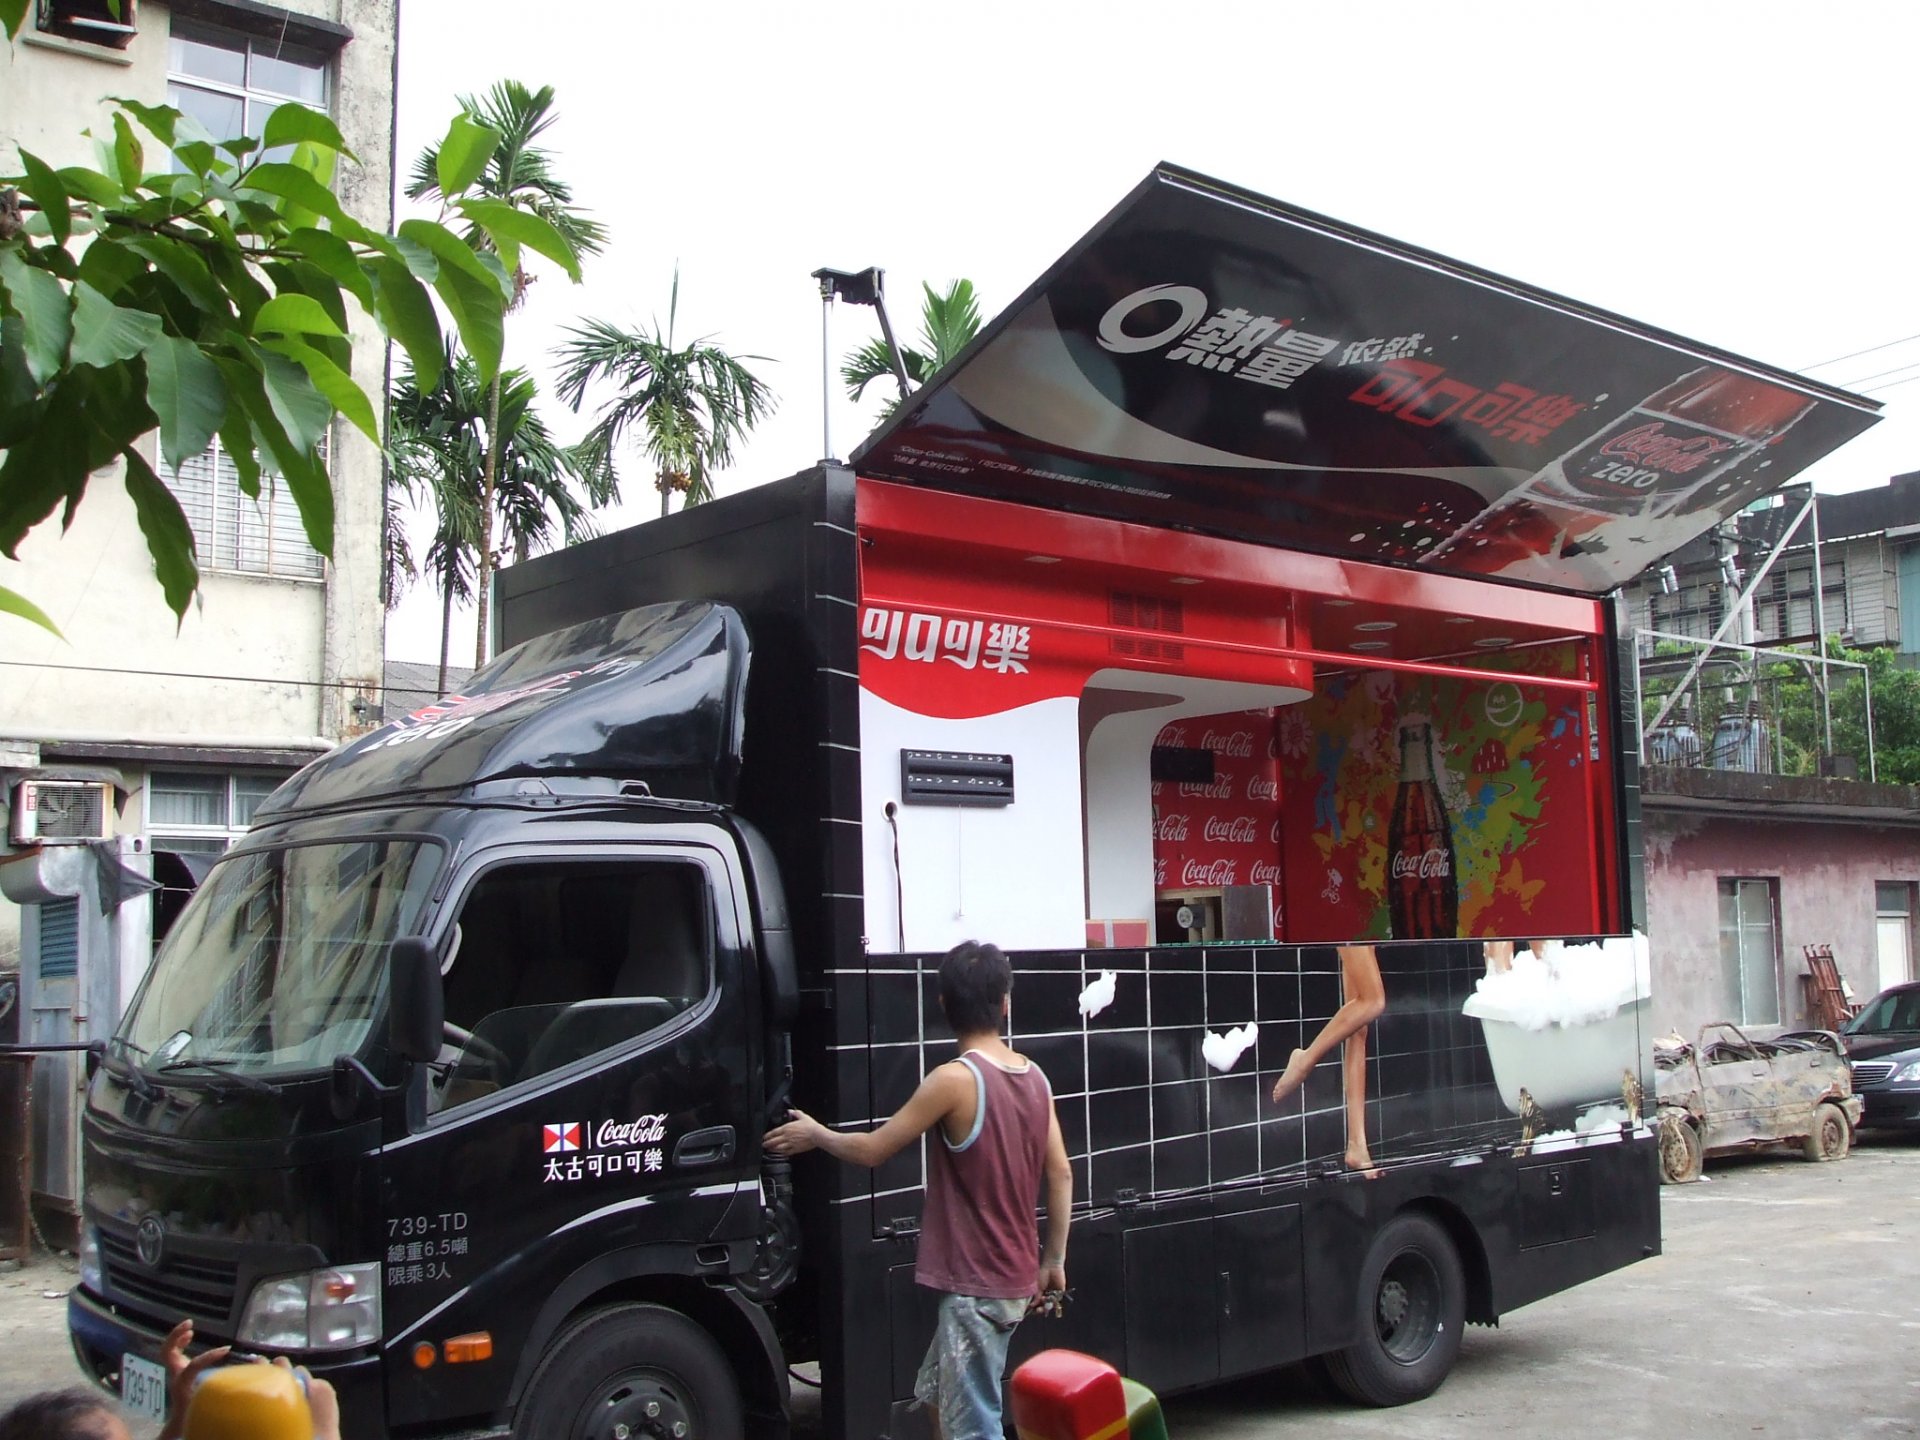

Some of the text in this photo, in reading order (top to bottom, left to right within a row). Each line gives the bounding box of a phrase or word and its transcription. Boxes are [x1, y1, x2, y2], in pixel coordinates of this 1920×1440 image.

[1338, 332, 1426, 367] 依然
[1349, 357, 1587, 447] 可口可樂
[1591, 461, 1661, 488] zero
[860, 607, 1032, 675] 可口可樂
[1204, 815, 1257, 842] Coca-Cola
[1182, 858, 1238, 886] Coca-Cola
[1392, 848, 1450, 879] Coca-Cola
[596, 1112, 669, 1149] Coca-Cola
[542, 1147, 663, 1184] 太古可口可樂
[387, 1211, 468, 1238] 739-TD
[124, 1366, 162, 1414] 739-TD
